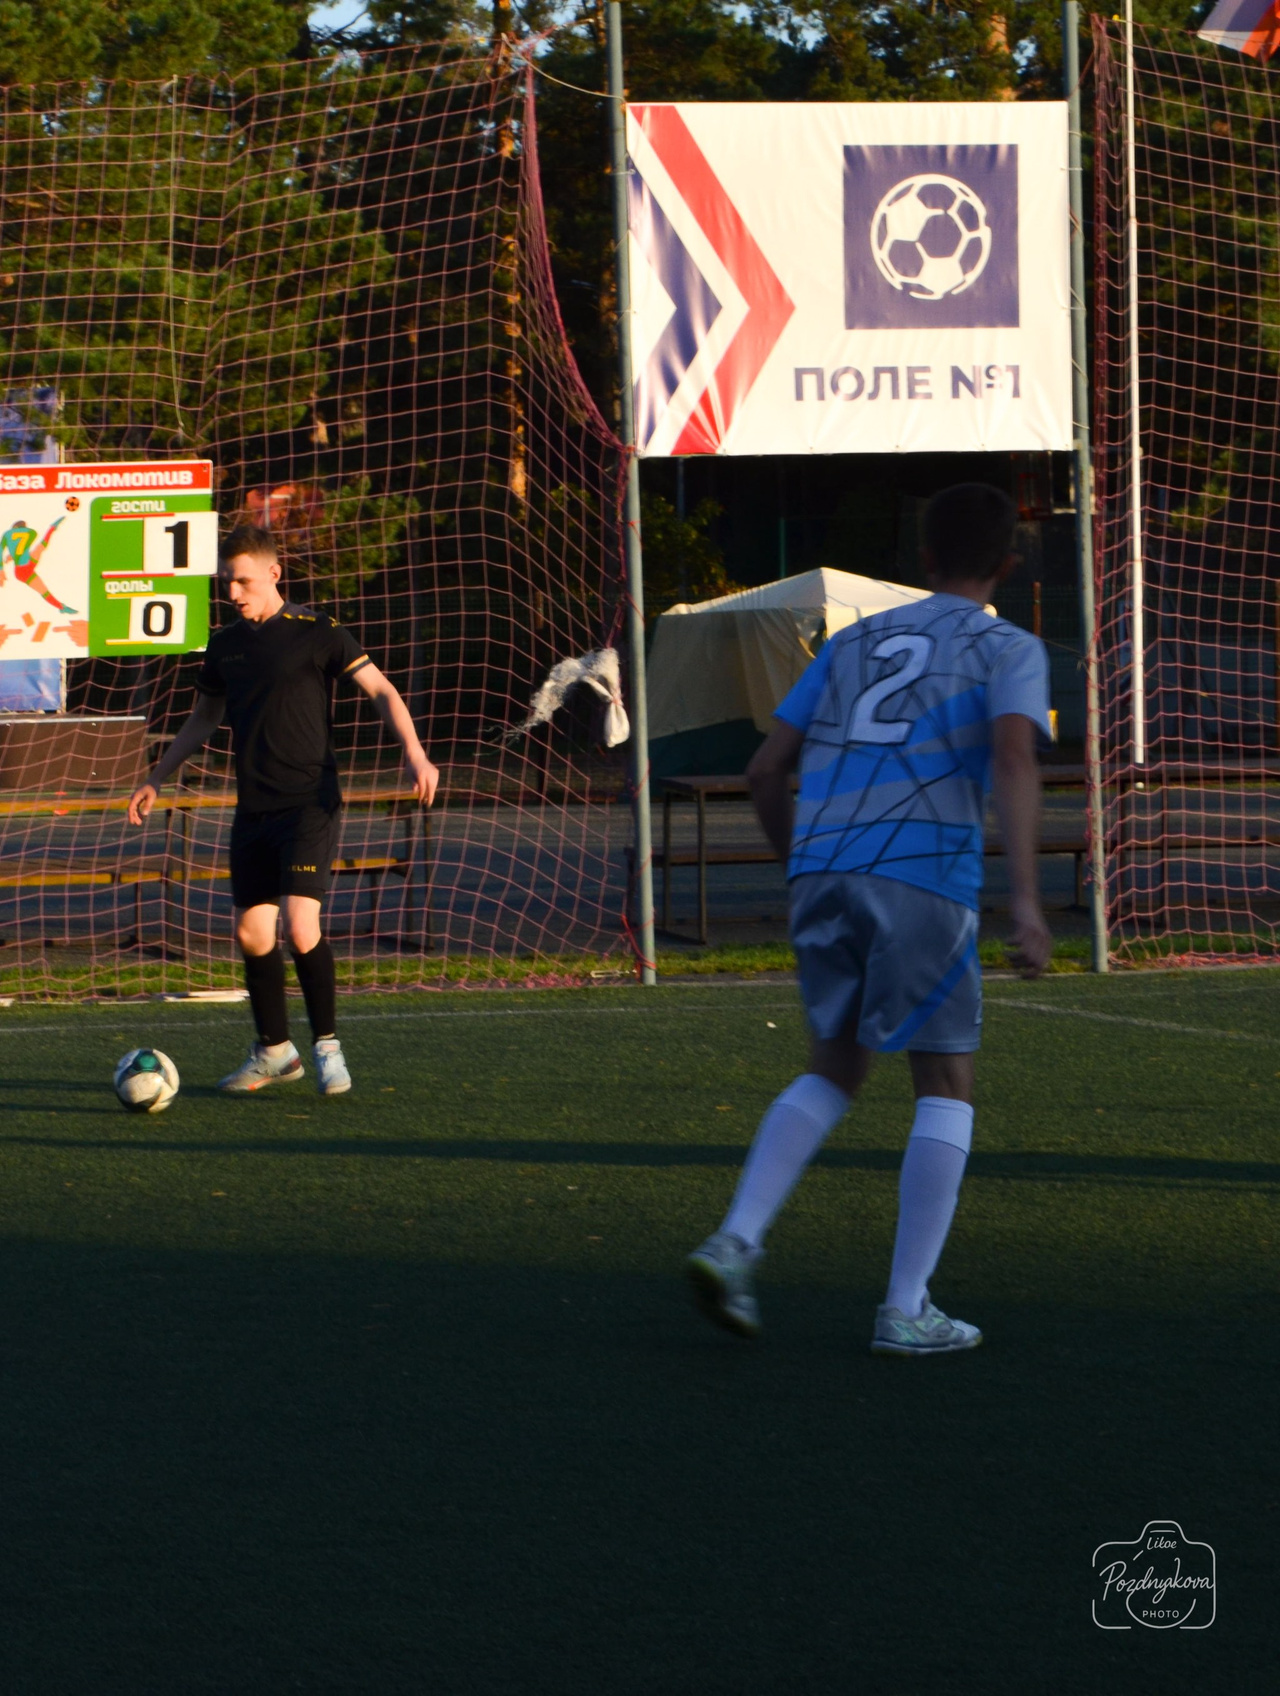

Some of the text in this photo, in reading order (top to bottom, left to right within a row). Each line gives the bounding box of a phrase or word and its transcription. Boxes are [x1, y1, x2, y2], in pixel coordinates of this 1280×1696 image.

[794, 366, 933, 401] ПОЛЕ
[55, 470, 194, 489] Локомотив
[111, 500, 166, 513] гости
[11, 532, 30, 555] 7
[162, 521, 189, 568] 1
[105, 579, 153, 594] фолы
[142, 600, 173, 637] 0
[846, 633, 932, 744] 2
[287, 864, 317, 873] ELME
